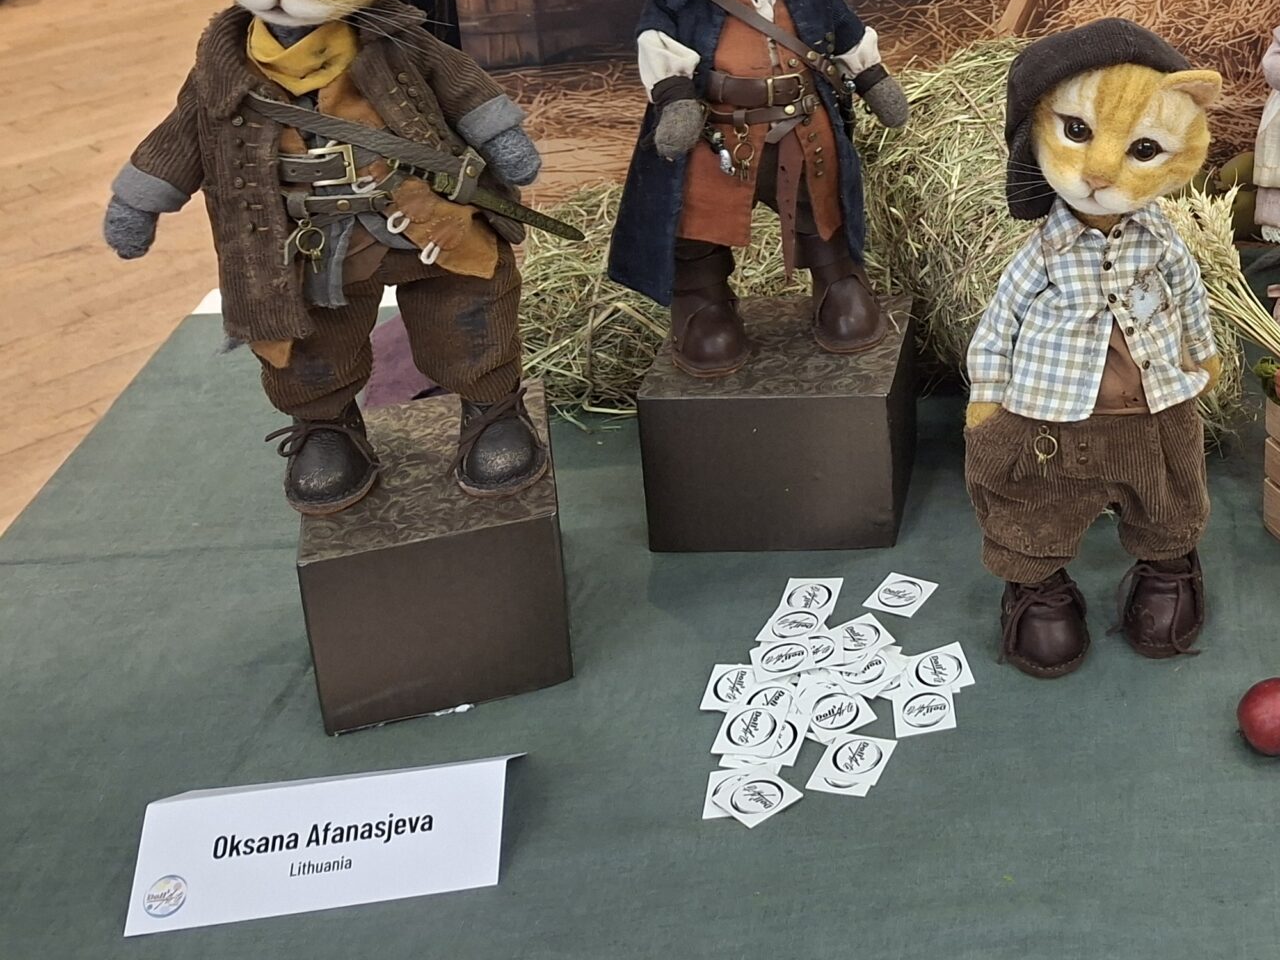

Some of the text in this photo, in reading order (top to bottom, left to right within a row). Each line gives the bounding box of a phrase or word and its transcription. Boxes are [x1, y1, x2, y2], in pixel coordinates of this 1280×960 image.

[212, 812, 435, 860] Oksana Afanasjeva
[289, 855, 353, 878] Lithuania
